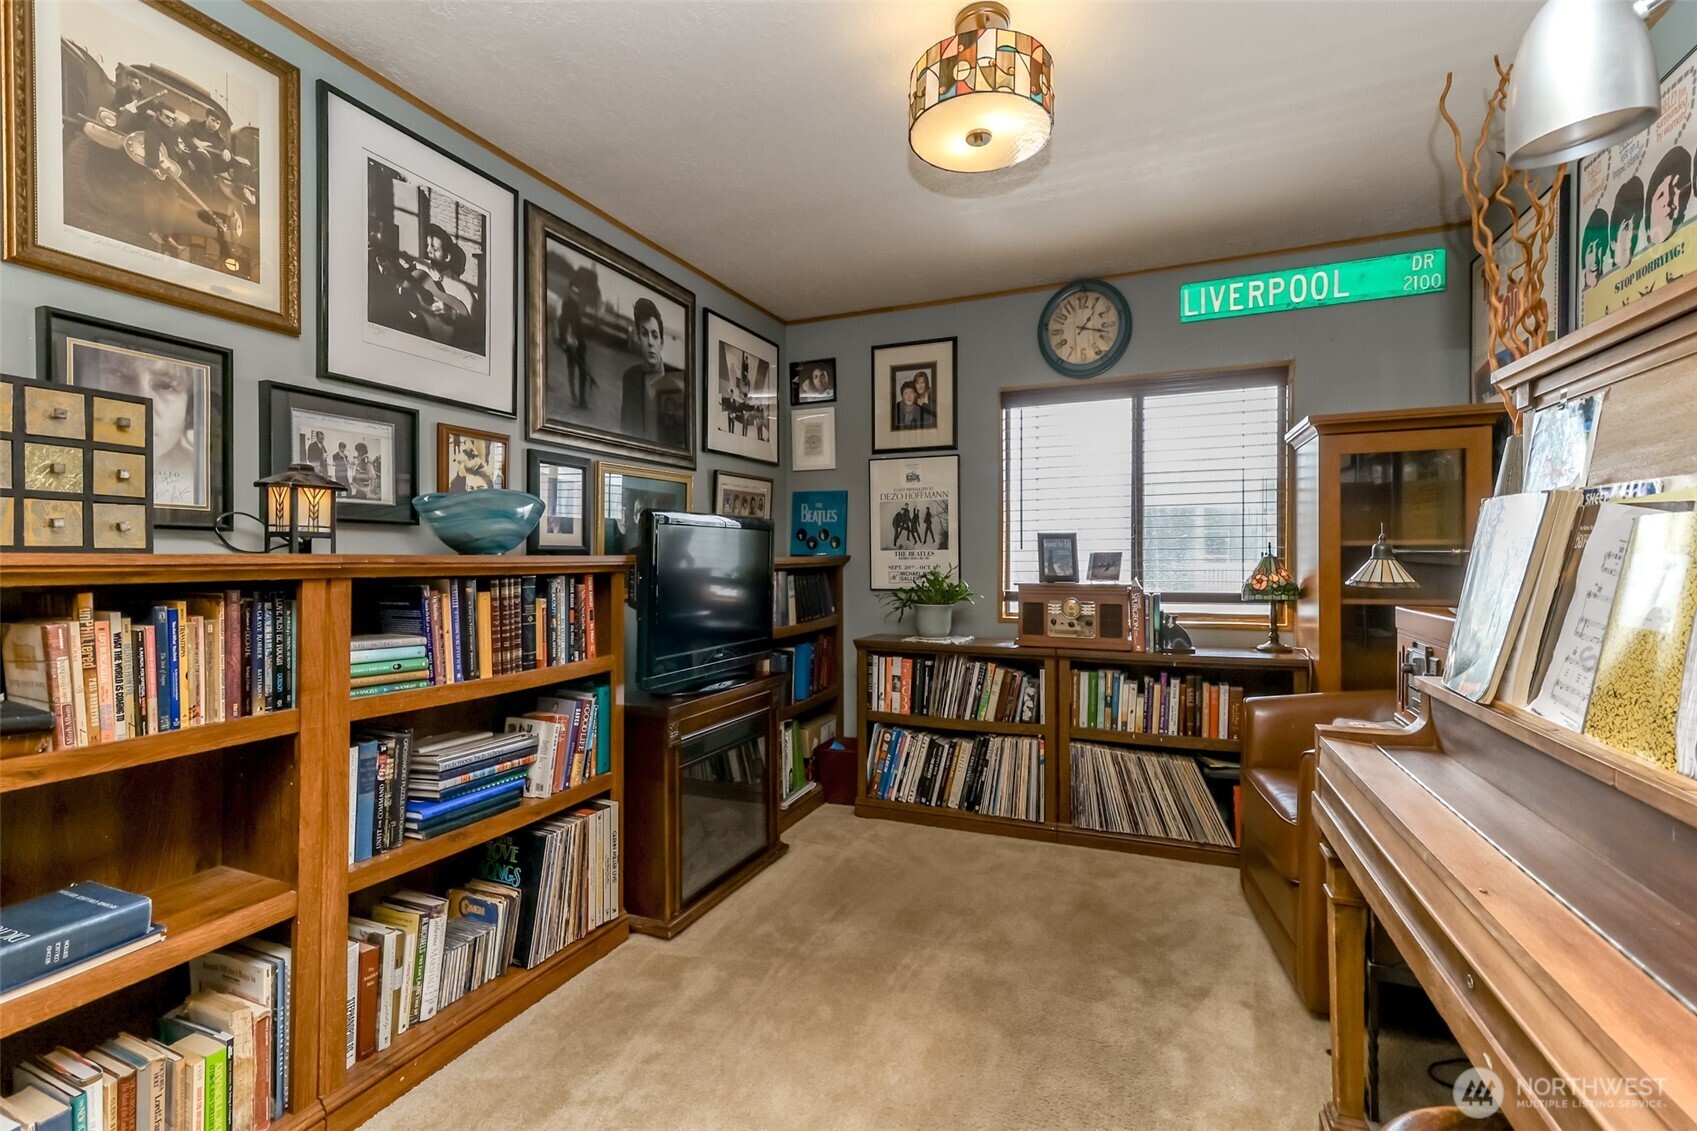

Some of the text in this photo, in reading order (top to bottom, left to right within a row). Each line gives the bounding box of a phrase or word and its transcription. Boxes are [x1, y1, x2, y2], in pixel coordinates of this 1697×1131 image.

[1412, 254, 1434, 270] DR
[1615, 242, 1684, 294] STOP WORRYING!
[1403, 274, 1441, 290] 2100
[1077, 295, 1089, 309] 12
[1184, 270, 1349, 316] LIVERPOOL
[881, 491, 948, 501] DEZO HOFFMANN
[801, 504, 837, 525] BEATLES
[113, 632, 123, 649] WHAT
[276, 634, 283, 642] BE
[114, 651, 123, 662] THE
[114, 664, 124, 684] WORLD
[88, 678, 97, 692] PHIL
[116, 692, 125, 712] COMING
[64, 705, 74, 746] Mitch Albom
[581, 707, 590, 732] GOOD
[578, 733, 586, 752] LIFE
[487, 841, 519, 863] LOVE
[481, 862, 521, 887] SONGS
[470, 904, 485, 916] MGM
[62, 939, 70, 959] EDITION
[418, 926, 428, 954] MICHAELS
[426, 946, 438, 989] MARSHALL
